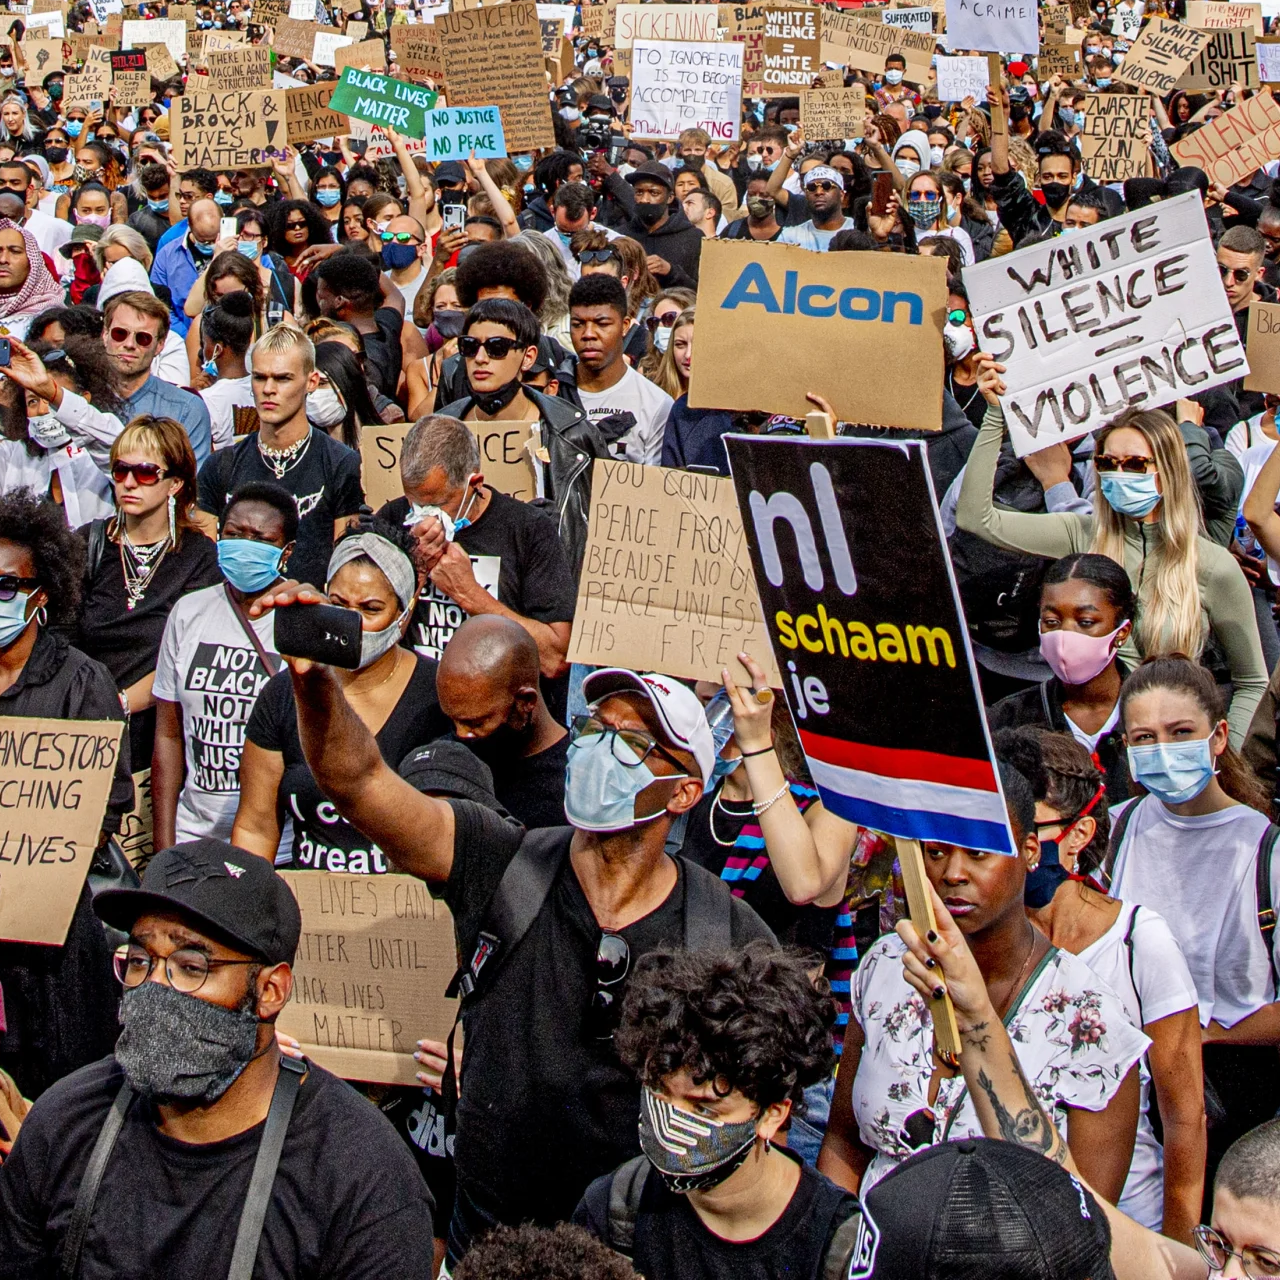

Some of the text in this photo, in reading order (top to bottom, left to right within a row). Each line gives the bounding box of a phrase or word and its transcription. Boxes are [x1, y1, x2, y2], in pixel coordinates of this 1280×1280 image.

[440, 4, 537, 33] JUSTICE FOR
[766, 12, 814, 25] WHITE
[766, 26, 816, 39] SILENCE
[1159, 20, 1205, 44] WHITE
[1040, 48, 1060, 57] BLACK
[1141, 31, 1198, 61] SILENCE
[1208, 33, 1255, 60] BULL-
[210, 50, 267, 63] THERE IS NO
[635, 49, 742, 68] TO IGNORE EVIL
[765, 57, 811, 70] WHITE
[70, 75, 102, 84] BLACK
[211, 63, 271, 79] VACCINE AGAINST
[655, 71, 741, 85] IS TO BECOME
[765, 71, 817, 84] CONSENT
[1040, 64, 1079, 75] MATTER
[1208, 61, 1255, 86] SHIT
[70, 84, 97, 93] LIVES
[218, 78, 267, 89] STRUCTURAL
[347, 70, 430, 106] BLACK LIVES
[181, 93, 251, 113] BLACK
[633, 86, 727, 102] ACCOMPLICE
[354, 99, 411, 129] MATTER
[679, 106, 696, 118] TO
[1086, 95, 1148, 115] ZWARTE
[182, 114, 256, 128] BROWN
[432, 110, 495, 126] NO JUSTICE
[1085, 119, 1147, 137] LEVENS
[183, 129, 243, 147] LIVES
[434, 135, 496, 154] NO PEACE
[1095, 138, 1132, 158] ZIJN
[184, 148, 260, 166] MATTER
[1007, 215, 1160, 293] WHITE
[720, 262, 924, 324] Alcon
[982, 253, 1189, 362] SILENCE
[1010, 324, 1244, 438] VIOLENCE
[603, 461, 644, 499] YOU
[596, 503, 657, 546] PEACE
[749, 461, 857, 595] nl
[588, 545, 720, 585] BECAUSE NO
[584, 582, 657, 618] PEACE
[776, 604, 956, 668] schaam
[211, 648, 258, 672] NOT
[787, 660, 830, 719] je
[203, 695, 252, 718] NOT
[0, 835, 76, 866] LIVES
